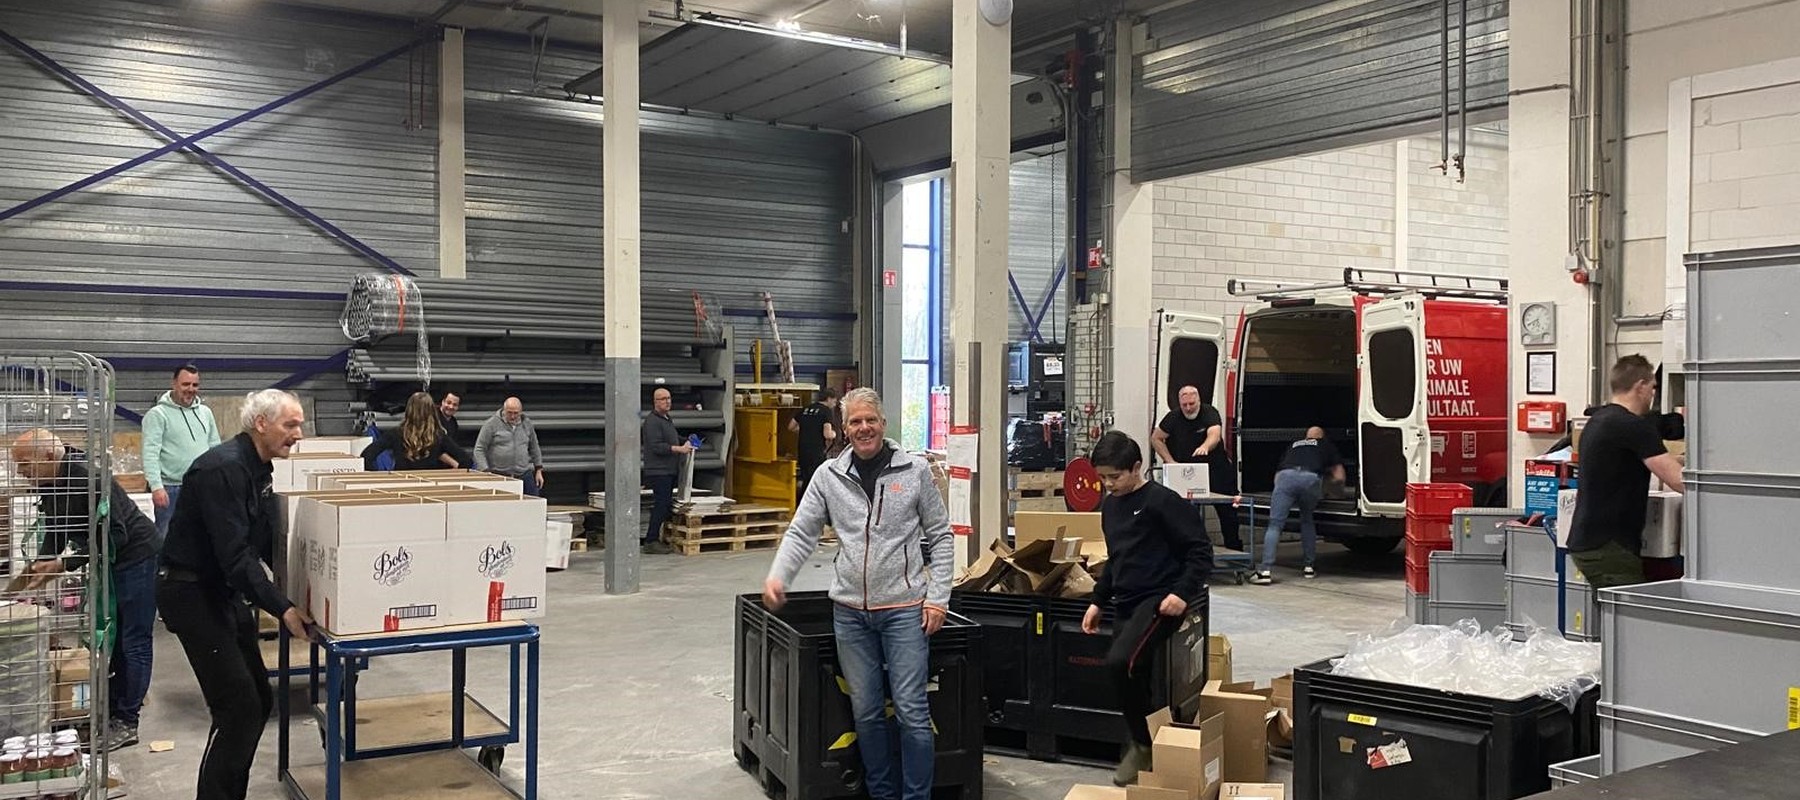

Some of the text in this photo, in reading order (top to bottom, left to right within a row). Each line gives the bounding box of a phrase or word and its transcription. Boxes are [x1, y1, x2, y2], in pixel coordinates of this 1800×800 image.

[1440, 358, 1462, 376] UW
[1428, 399, 1480, 417] ULTAAT.
[373, 546, 413, 581] Bols
[478, 540, 515, 573] Bols
